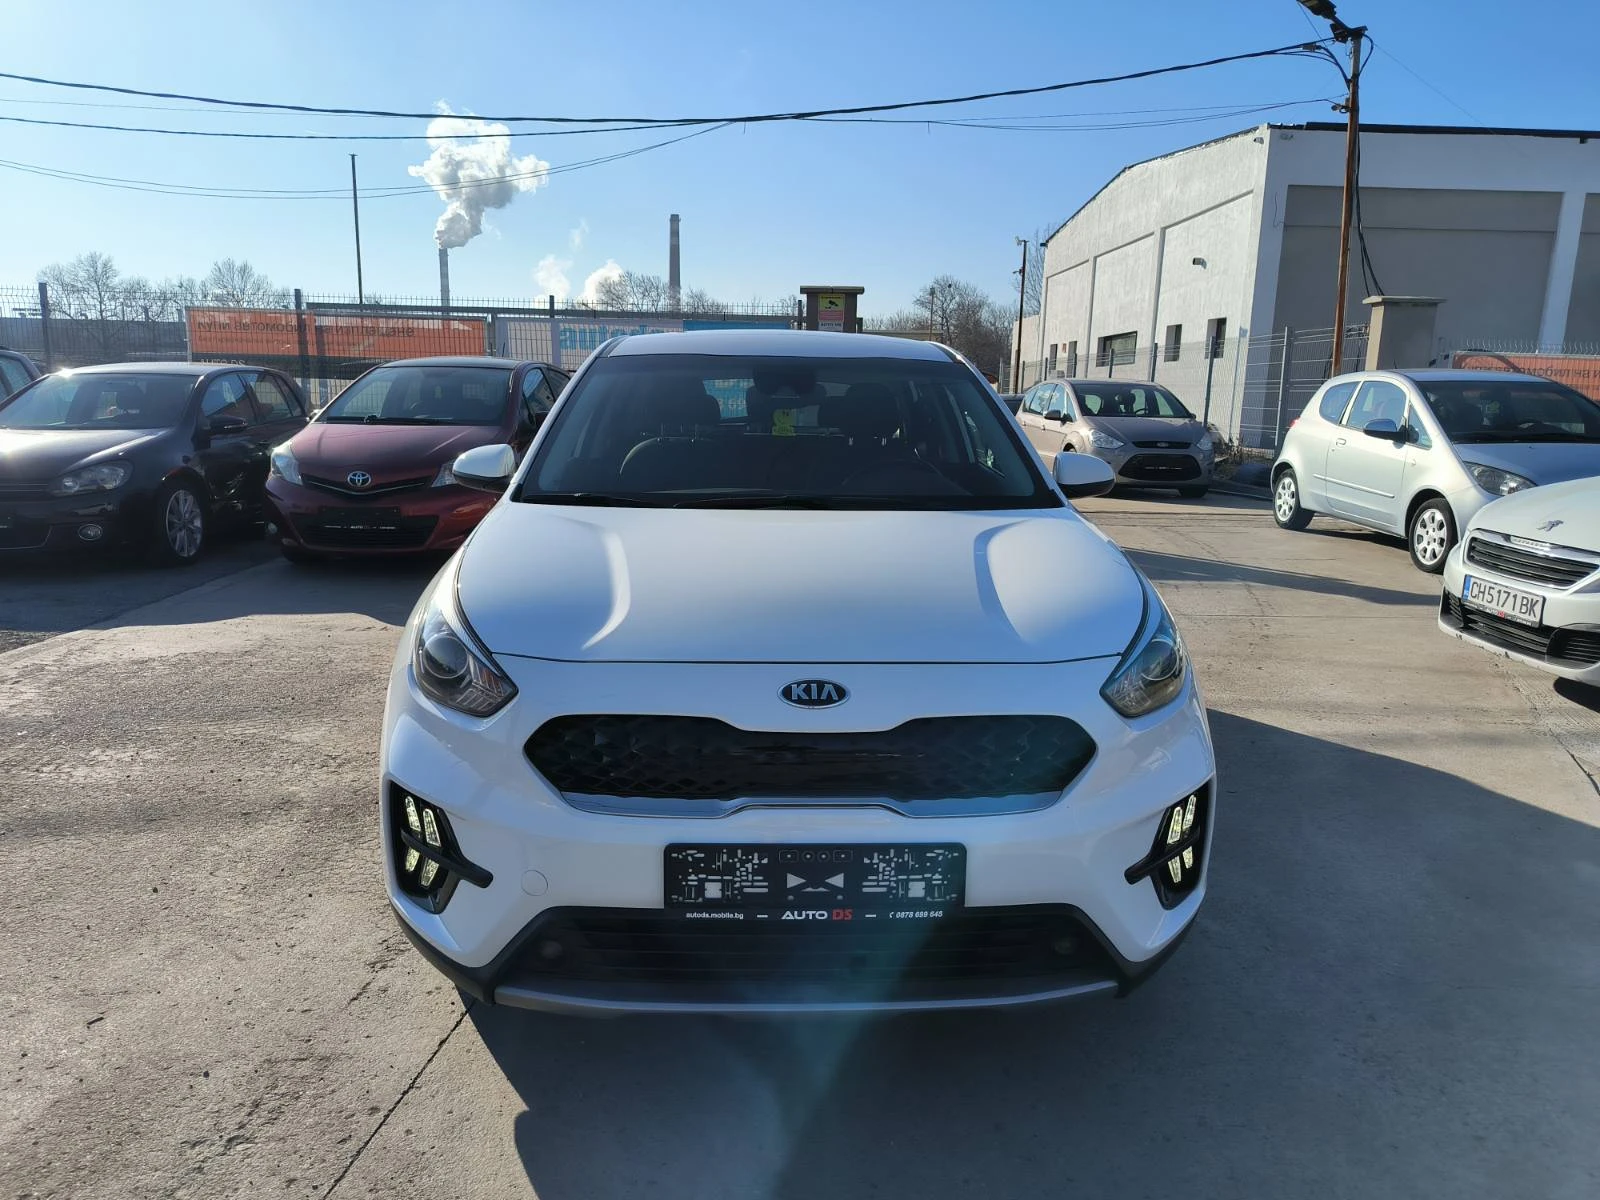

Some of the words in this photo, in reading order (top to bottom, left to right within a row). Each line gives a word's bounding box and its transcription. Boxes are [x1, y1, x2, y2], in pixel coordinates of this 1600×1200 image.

[791, 683, 839, 700] KIA
[781, 910, 828, 920] AUTO
[832, 909, 853, 920] DS
